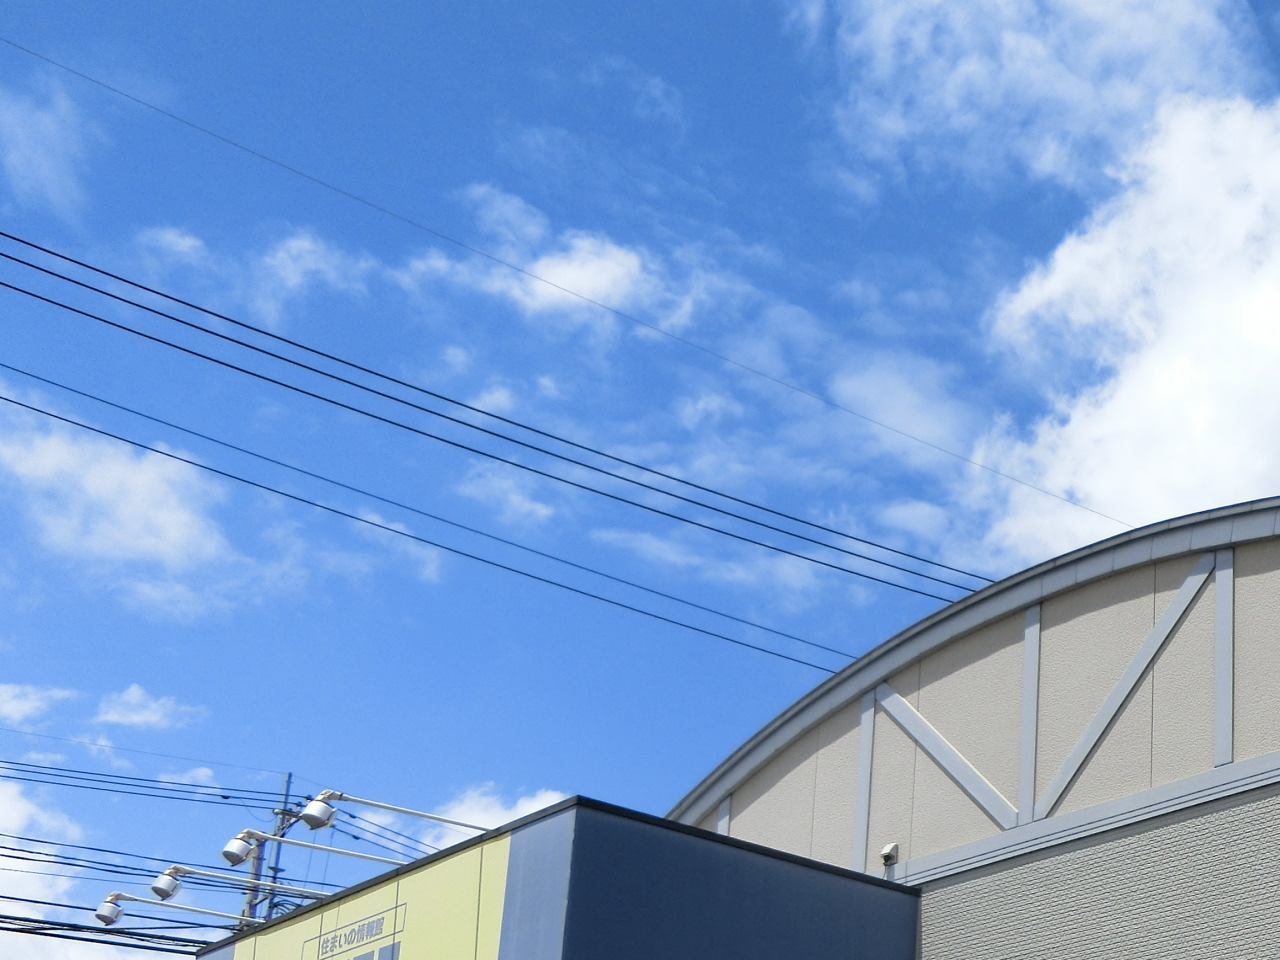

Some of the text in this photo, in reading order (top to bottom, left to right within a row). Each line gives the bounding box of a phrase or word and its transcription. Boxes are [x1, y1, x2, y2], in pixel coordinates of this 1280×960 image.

[321, 917, 385, 956] 住まいの情報館
